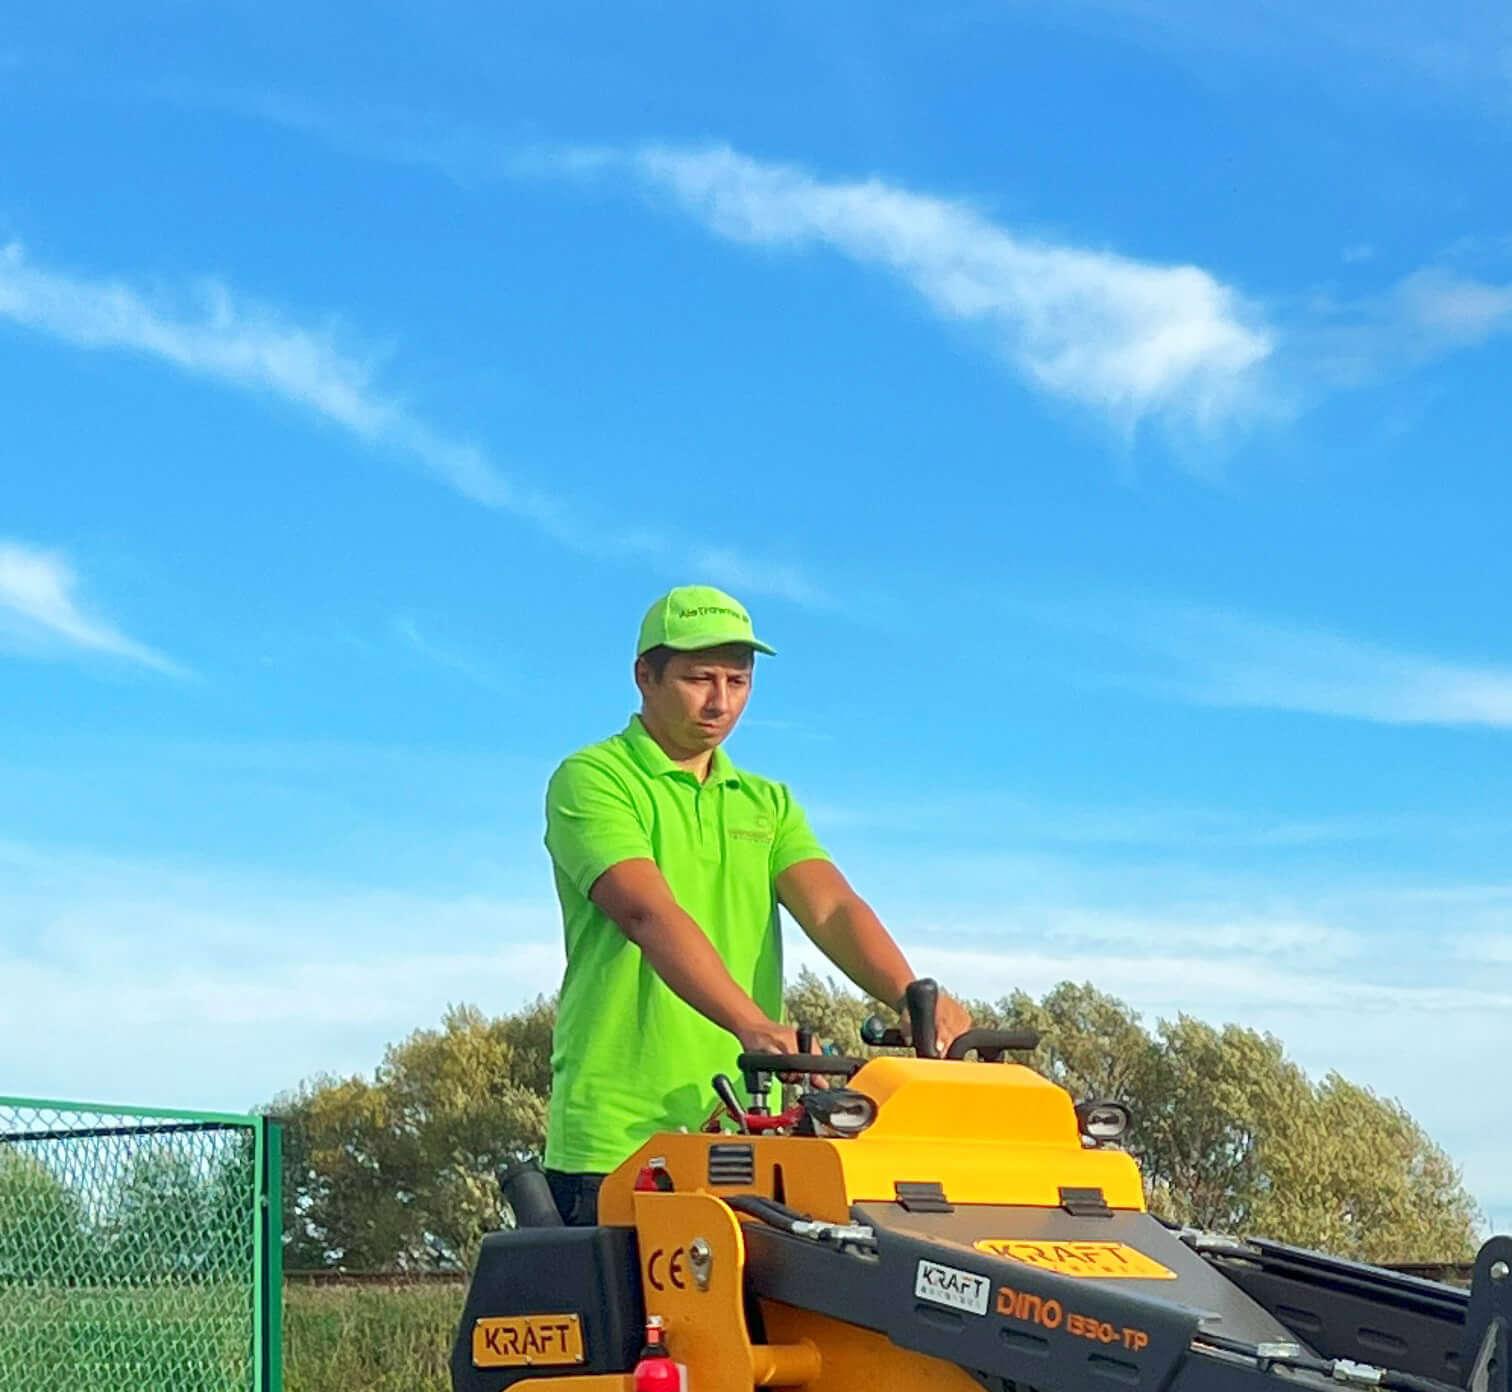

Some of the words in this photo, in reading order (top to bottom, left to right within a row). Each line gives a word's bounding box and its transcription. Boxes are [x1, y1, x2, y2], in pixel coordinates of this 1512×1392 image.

[647, 1247, 686, 1292] CE
[988, 1244, 1128, 1264] KRAFT
[922, 1265, 984, 1298] KRAFT
[484, 1324, 570, 1356] KRAFT
